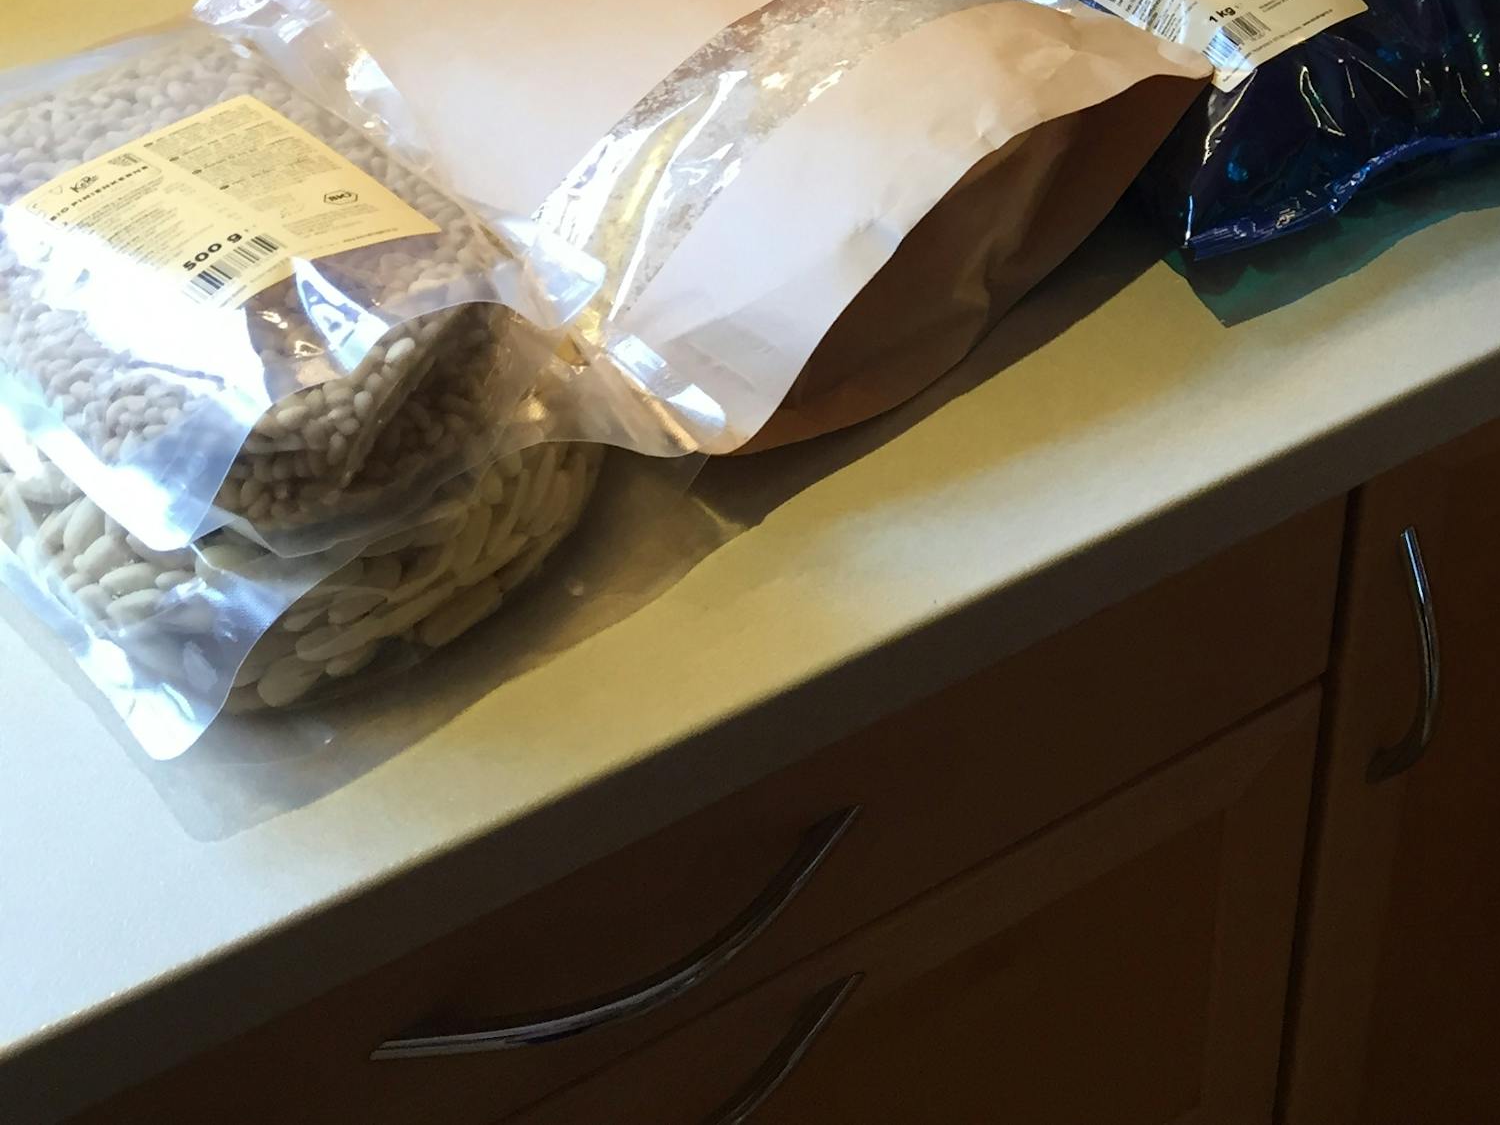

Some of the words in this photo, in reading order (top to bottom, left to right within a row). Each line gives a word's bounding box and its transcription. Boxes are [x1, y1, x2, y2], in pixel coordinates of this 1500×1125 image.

[1208, 14, 1218, 24] 1
[1217, 5, 1237, 19] kg
[50, 206, 70, 221] BIO
[71, 165, 149, 208] PINIENKERNE
[182, 242, 222, 272] 500
[226, 232, 243, 244] g
